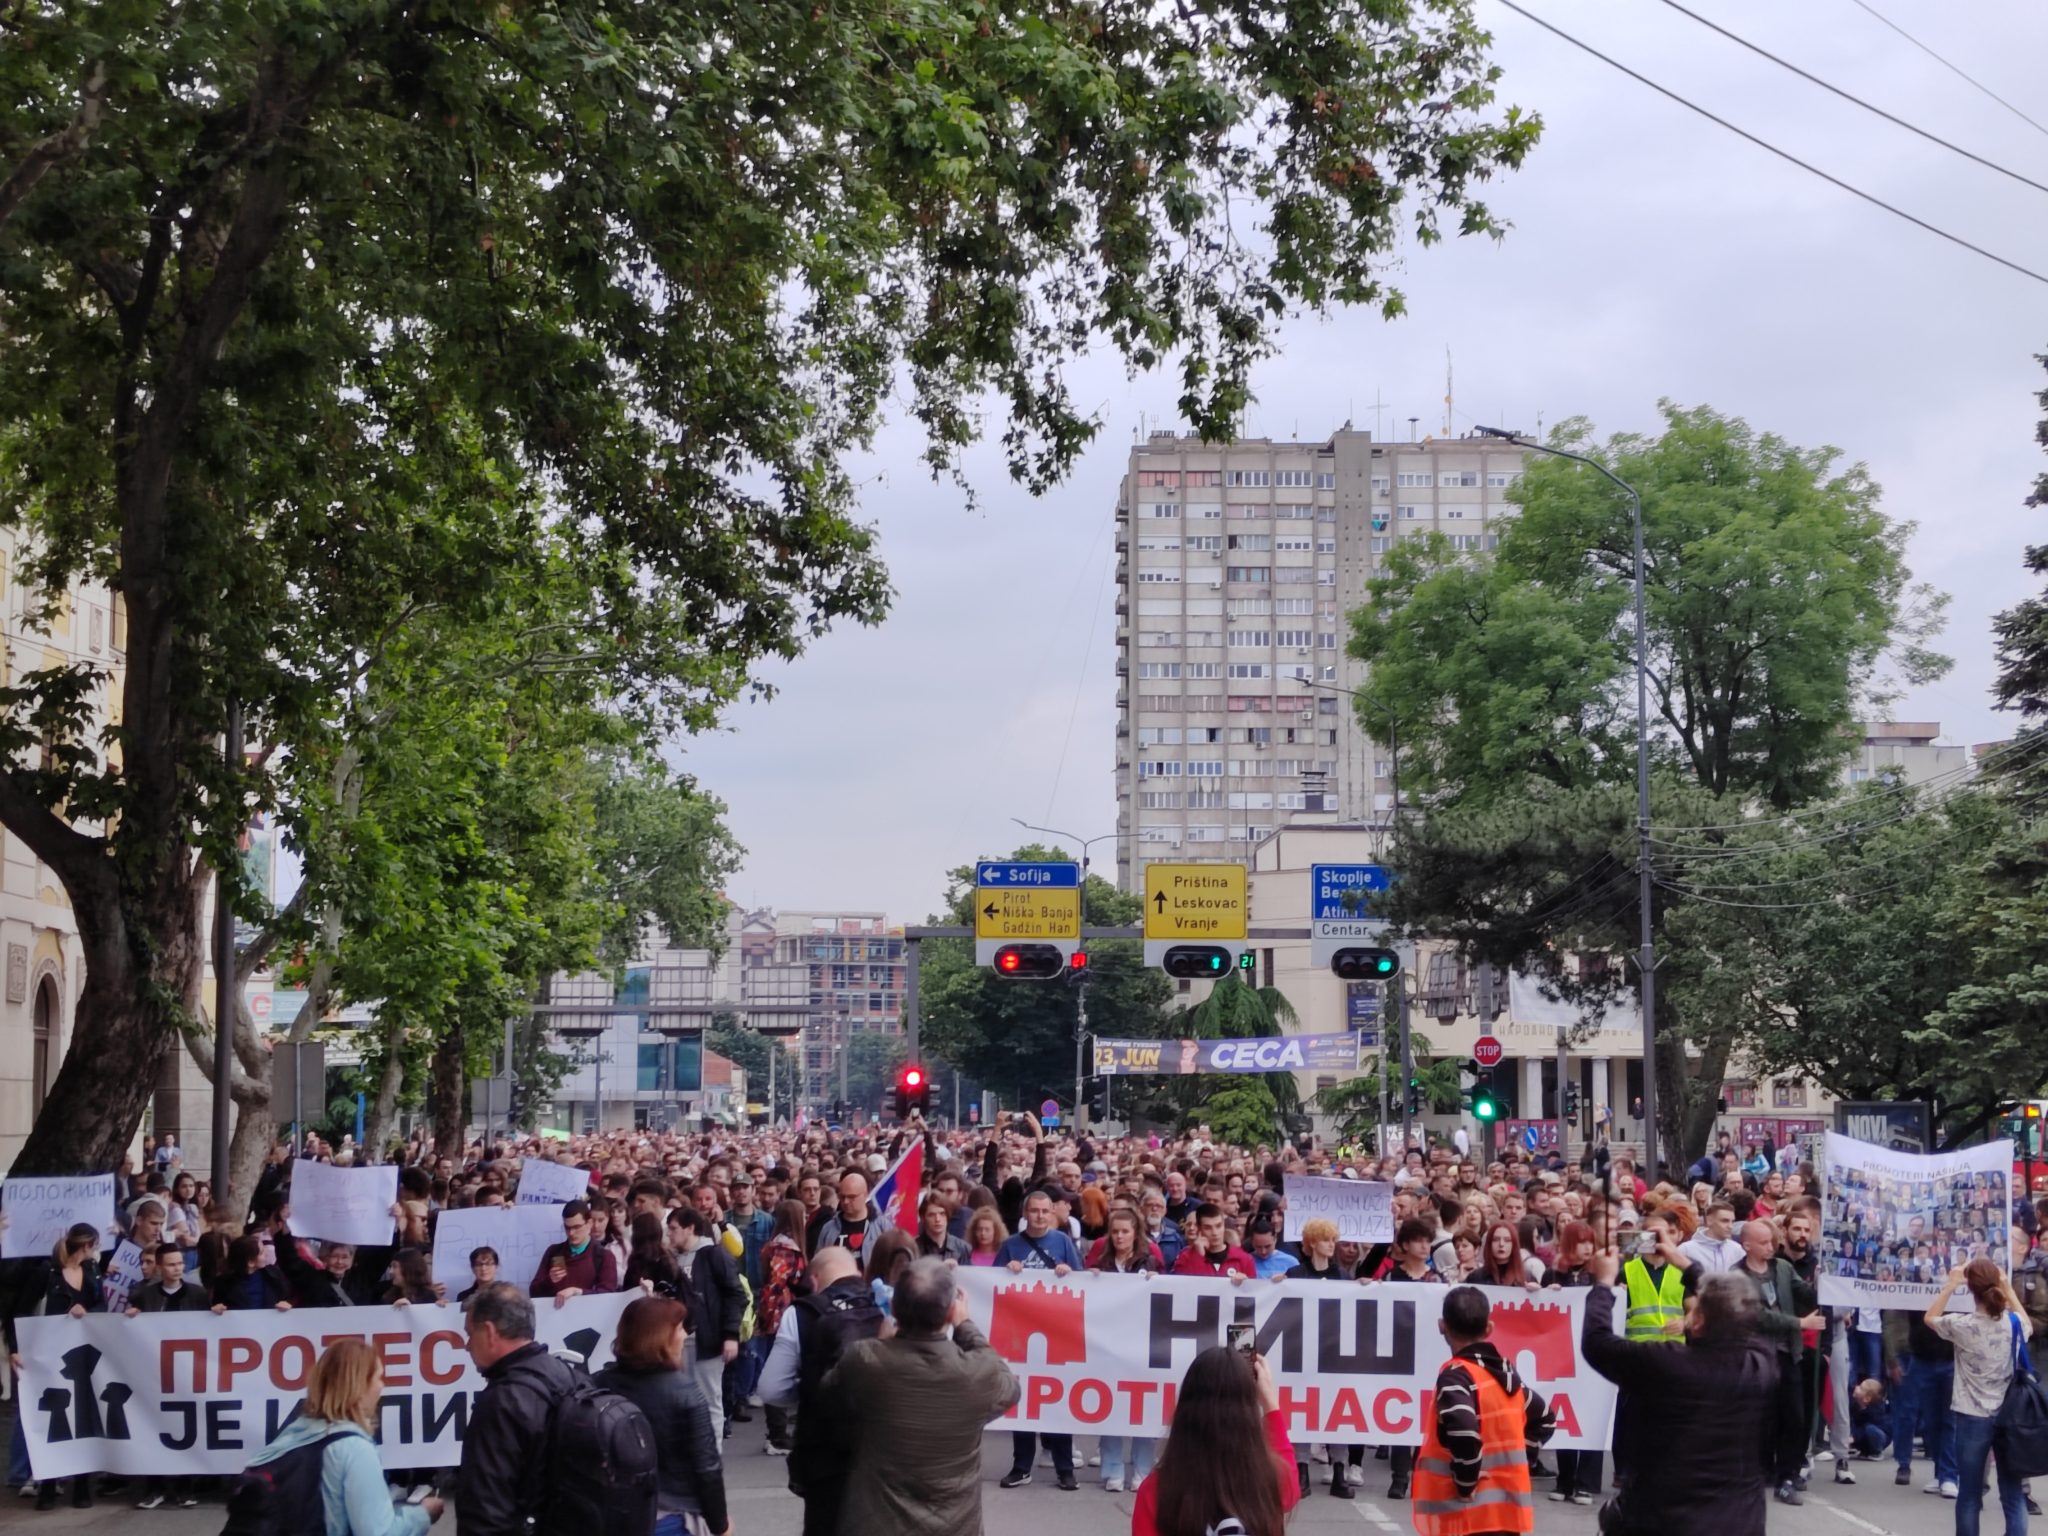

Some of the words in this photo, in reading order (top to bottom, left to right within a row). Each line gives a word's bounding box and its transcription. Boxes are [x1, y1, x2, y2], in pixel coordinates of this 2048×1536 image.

[1009, 868, 1051, 884] Sofija
[1173, 875, 1228, 888] Priština
[1321, 870, 1372, 886] Skoplje
[1003, 892, 1030, 904] Pirot
[1173, 896, 1238, 909] Leskovac
[1003, 905, 1034, 918] Niška
[1041, 906, 1073, 920] Banja
[1003, 921, 1042, 934] Gadžin
[1049, 922, 1071, 934] Han
[1174, 917, 1219, 931] Vranje
[1321, 923, 1368, 936] Centar
[1241, 955, 1254, 968] 21
[1121, 1048, 1161, 1066] JUN
[1210, 1039, 1304, 1069] CECA
[1476, 1045, 1500, 1057] STOP
[1847, 1115, 1887, 1141] NOVI
[1853, 1281, 1922, 1295] PROMOTERI
[1149, 1293, 1416, 1375] НИШ
[158, 1400, 244, 1451] ЈЕ
